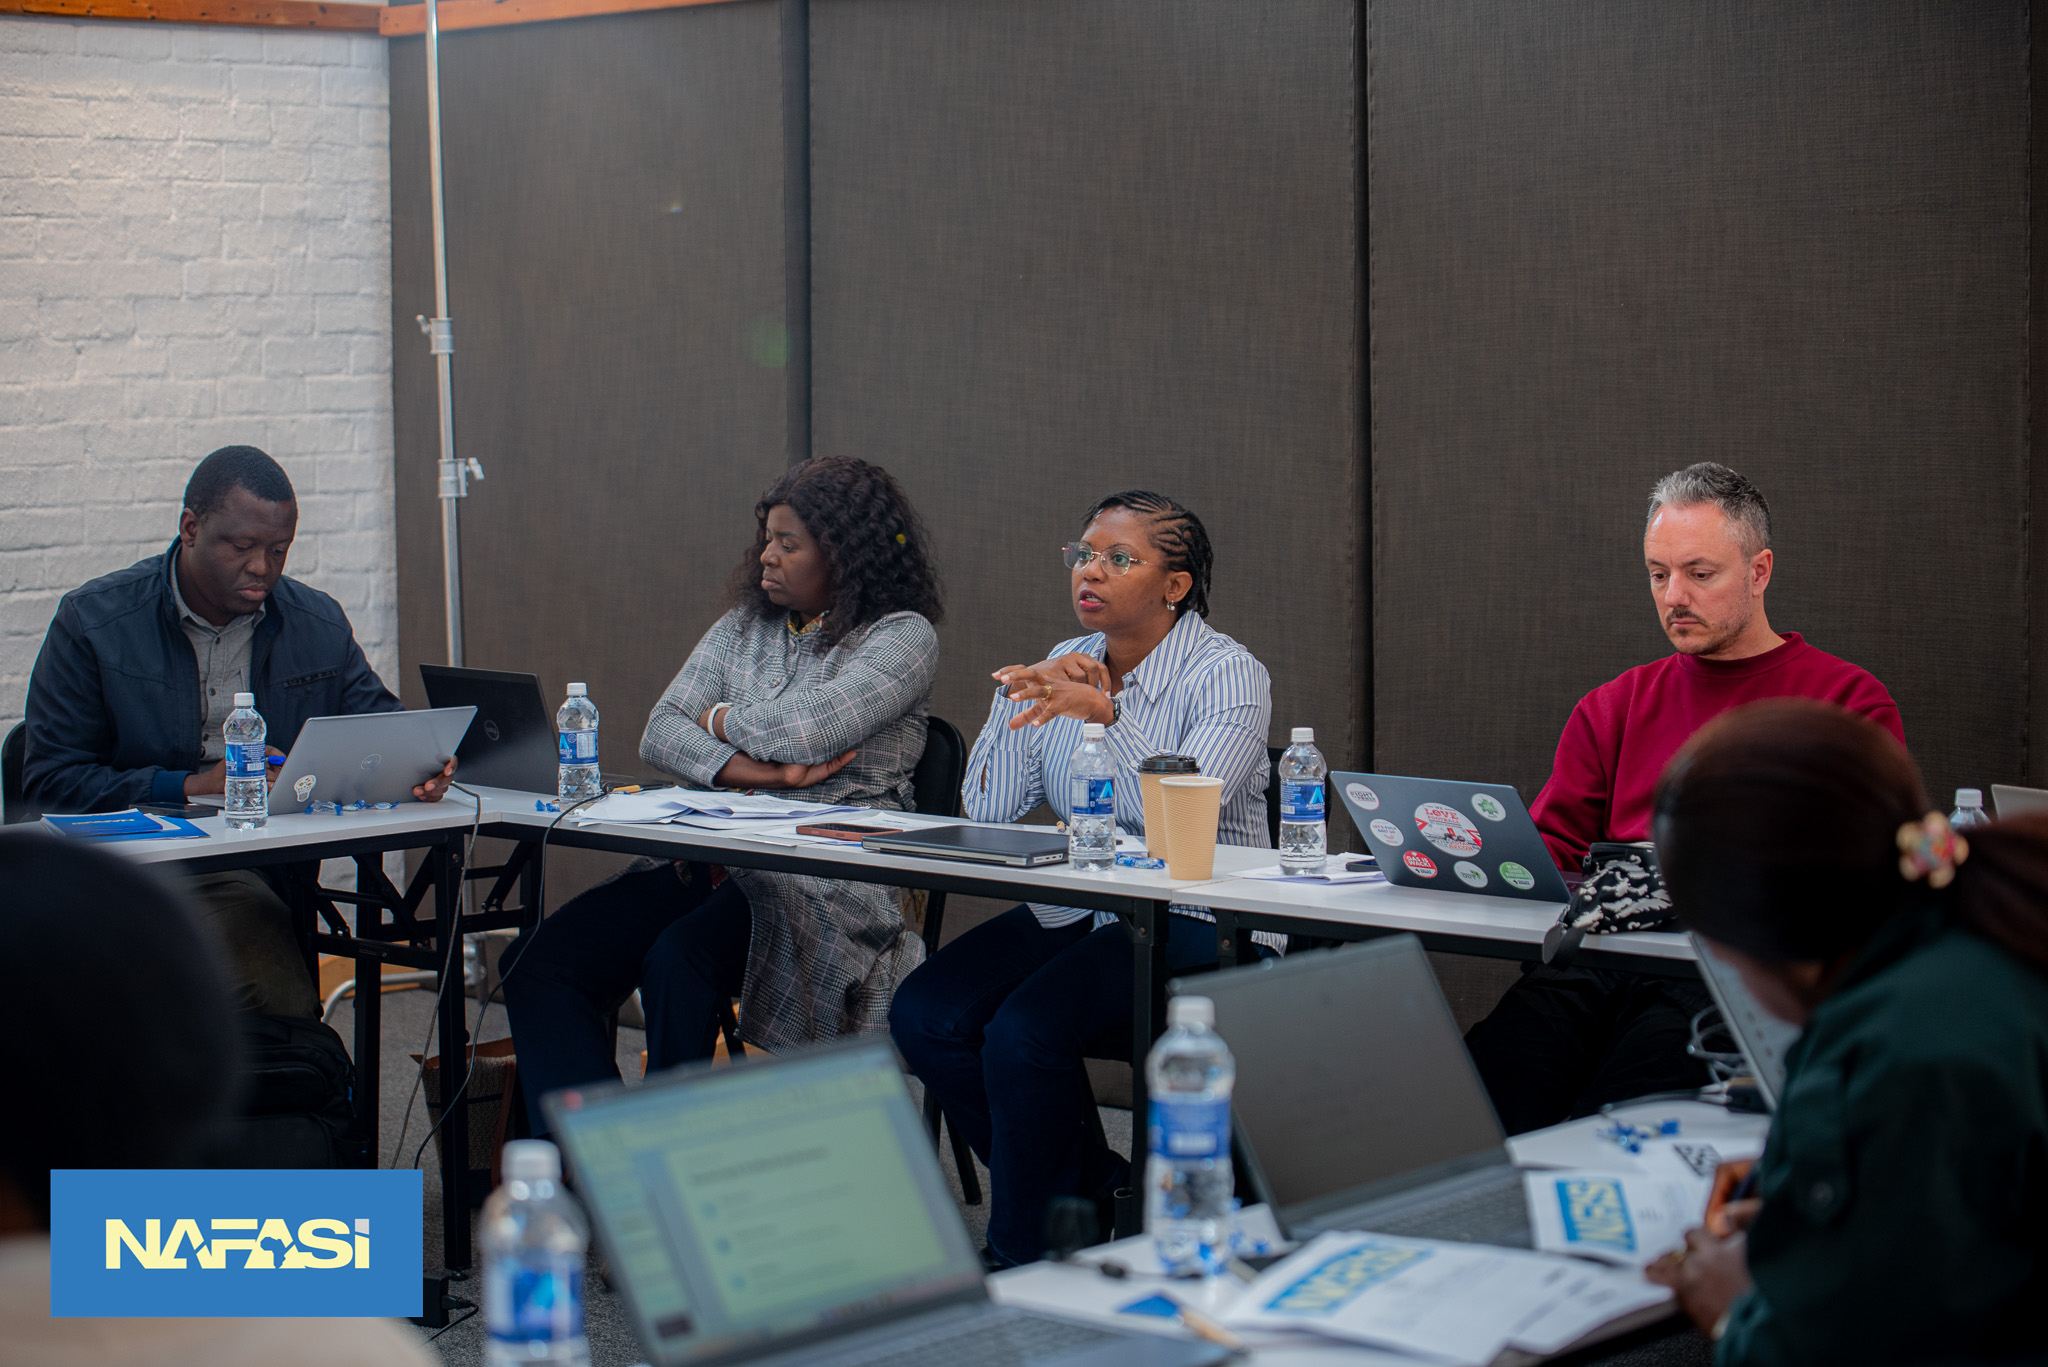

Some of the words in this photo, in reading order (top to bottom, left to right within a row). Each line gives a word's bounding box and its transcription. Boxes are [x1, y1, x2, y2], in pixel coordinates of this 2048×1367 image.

[1350, 791, 1375, 799] FIGHT
[1424, 807, 1459, 820] LOVE
[1427, 815, 1461, 825] FOOTBALL
[1406, 855, 1421, 863] GAS
